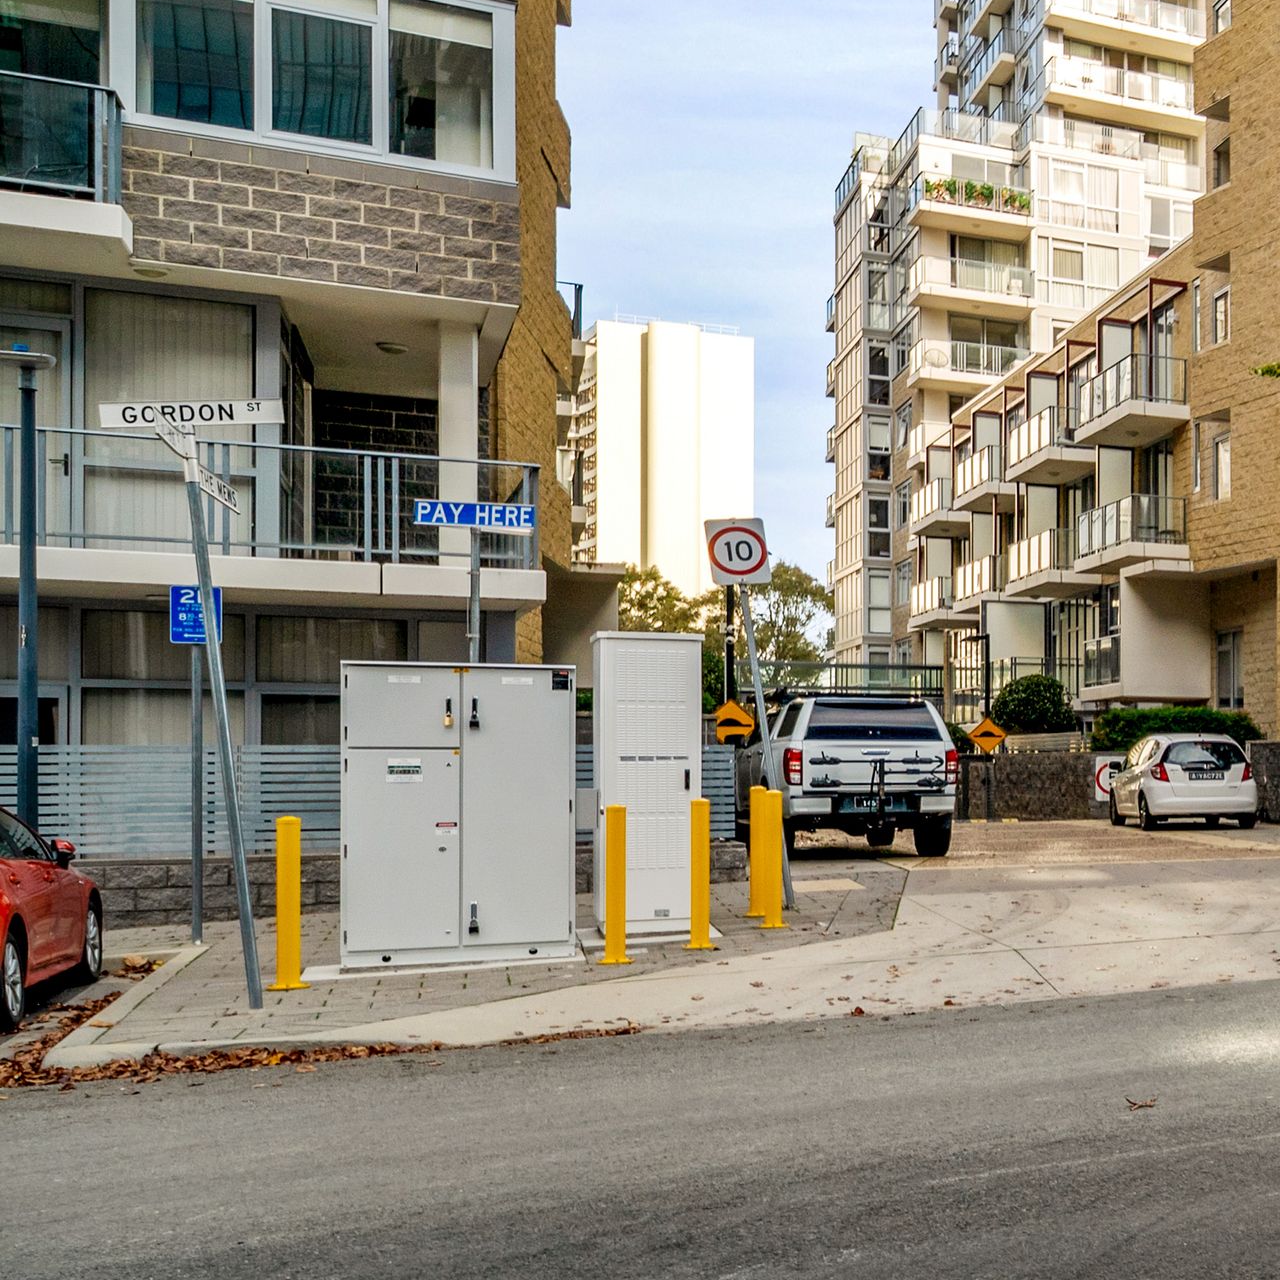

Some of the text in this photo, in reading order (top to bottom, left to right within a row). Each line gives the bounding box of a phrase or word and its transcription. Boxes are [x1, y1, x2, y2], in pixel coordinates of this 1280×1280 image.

[121, 402, 262, 424] GORDON ST
[217, 481, 238, 508] MEWS
[417, 502, 533, 527] PAY HERE
[724, 540, 753, 562] 10
[180, 589, 202, 604] 2
